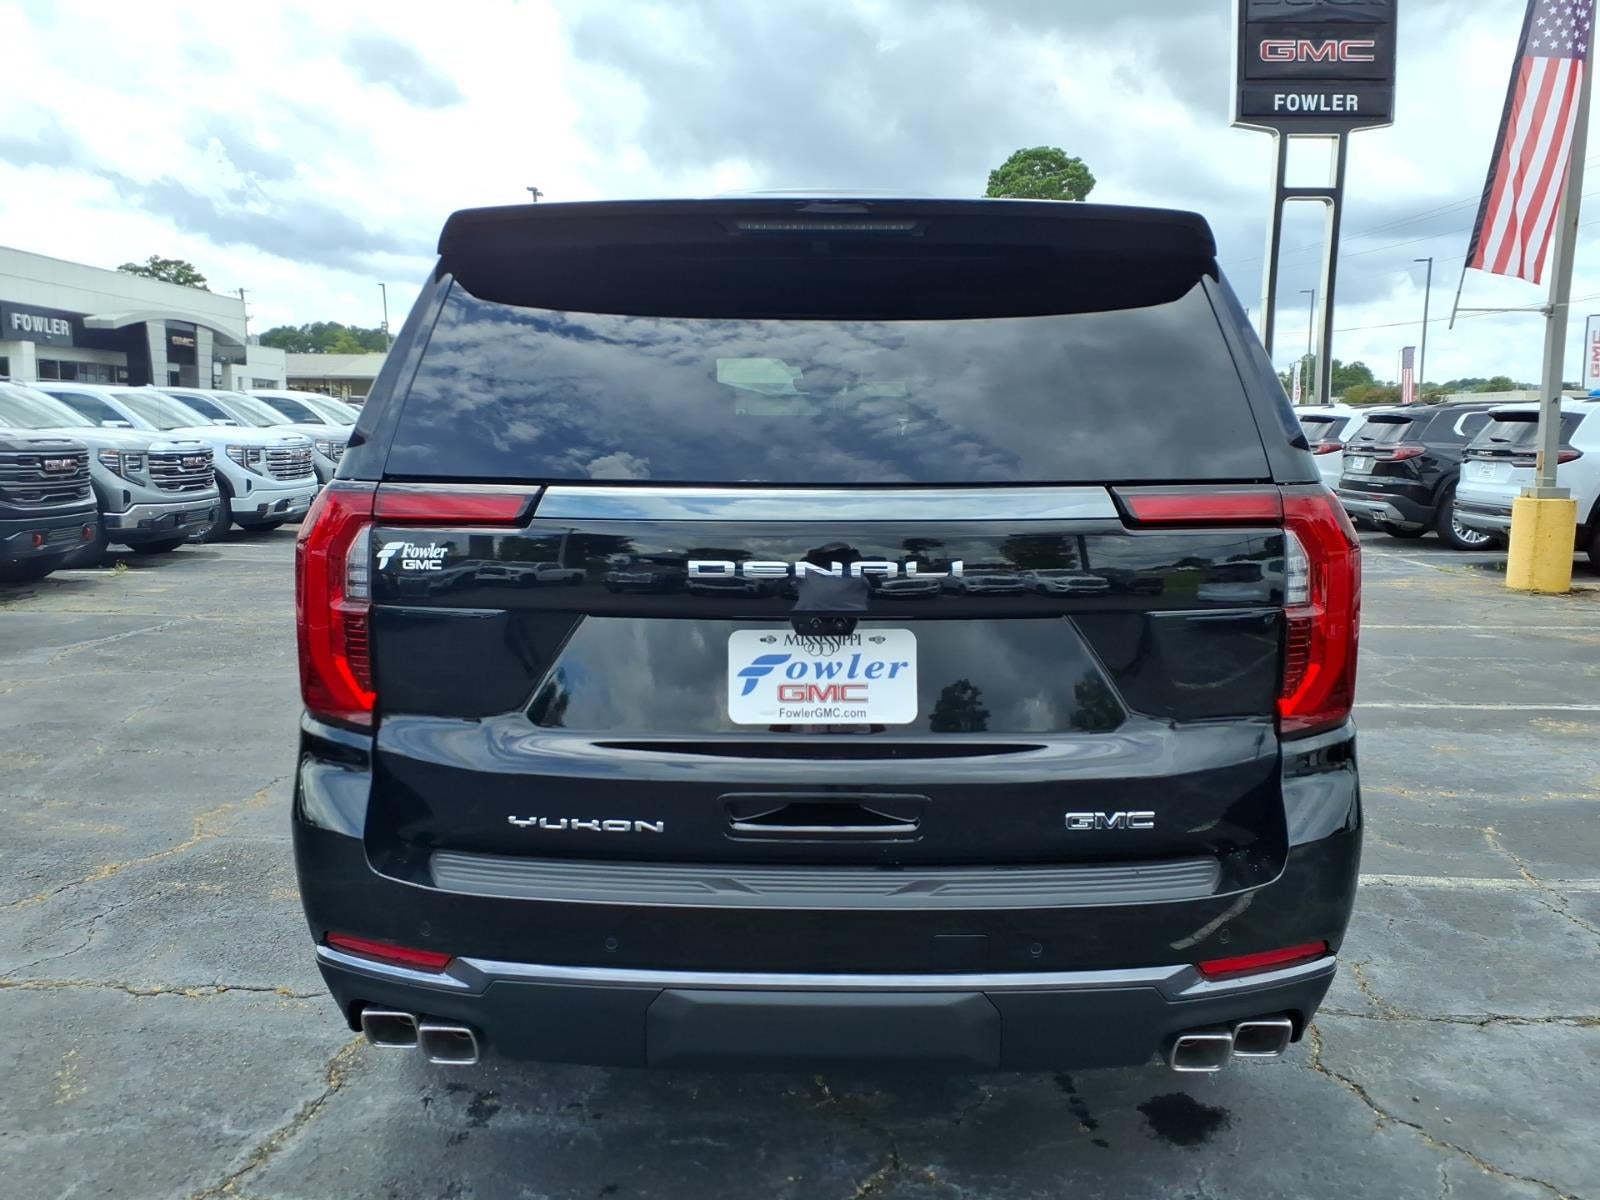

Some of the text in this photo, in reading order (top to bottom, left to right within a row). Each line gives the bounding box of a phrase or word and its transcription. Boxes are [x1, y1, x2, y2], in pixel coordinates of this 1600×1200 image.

[1260, 40, 1375, 62] GMC
[1274, 94, 1358, 111] FOWLER
[11, 312, 70, 336] FOWLER
[401, 542, 448, 558] Fowler
[402, 559, 442, 570] GMC
[688, 560, 964, 579] DENALI
[737, 653, 909, 697] Fowler
[776, 682, 869, 704] GMC
[779, 707, 867, 720] FowlerGMC.com
[508, 815, 664, 833] YUKON
[1065, 811, 1155, 830] GMC
